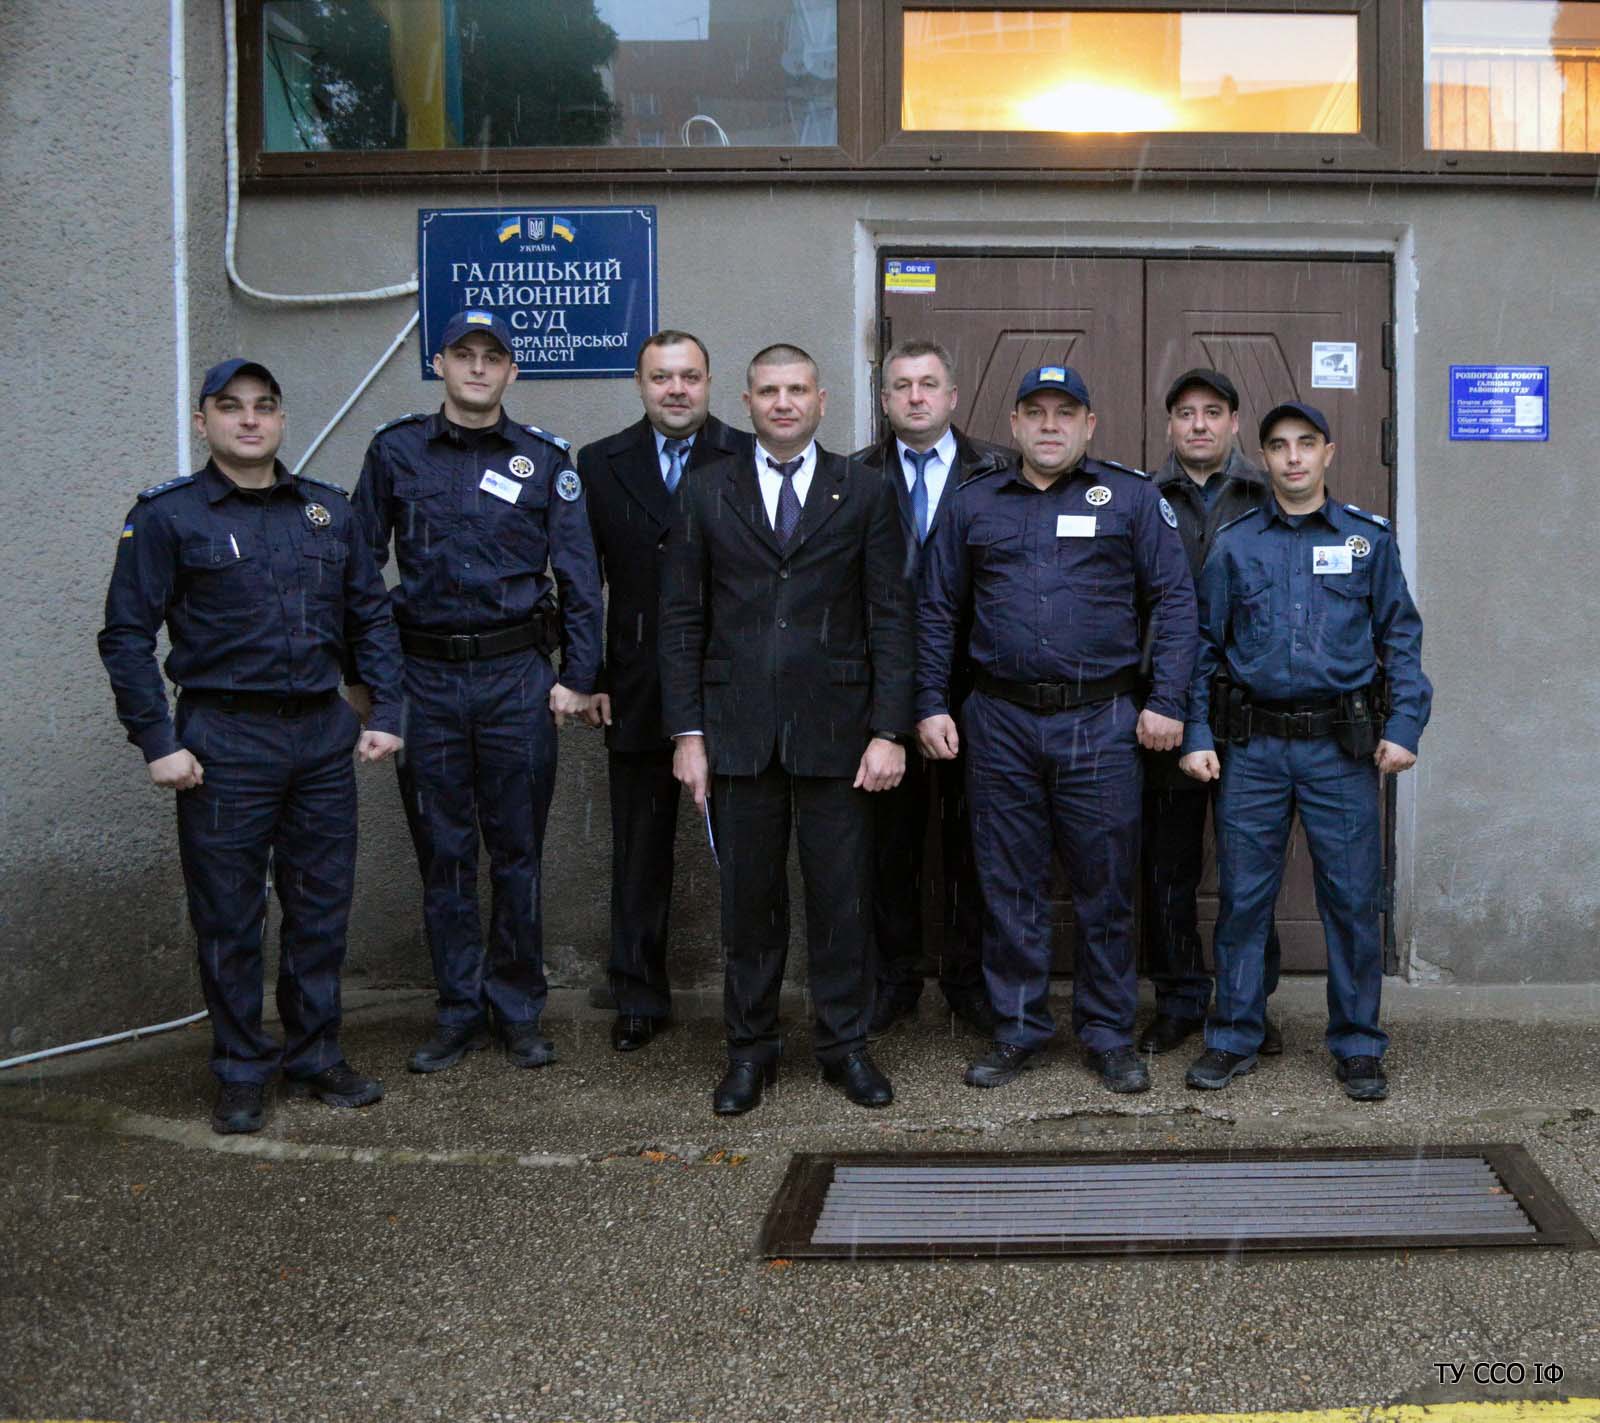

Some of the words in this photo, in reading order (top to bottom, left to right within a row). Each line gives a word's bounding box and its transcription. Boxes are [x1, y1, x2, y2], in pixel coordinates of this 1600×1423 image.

[519, 244, 556, 252] УКРАЇНА
[451, 258, 622, 285] ГАЛИЦЬКИЙ
[464, 282, 611, 307] РАЙОННИЙ
[511, 310, 568, 333] СУД
[514, 347, 575, 362] БЛАСТІ
